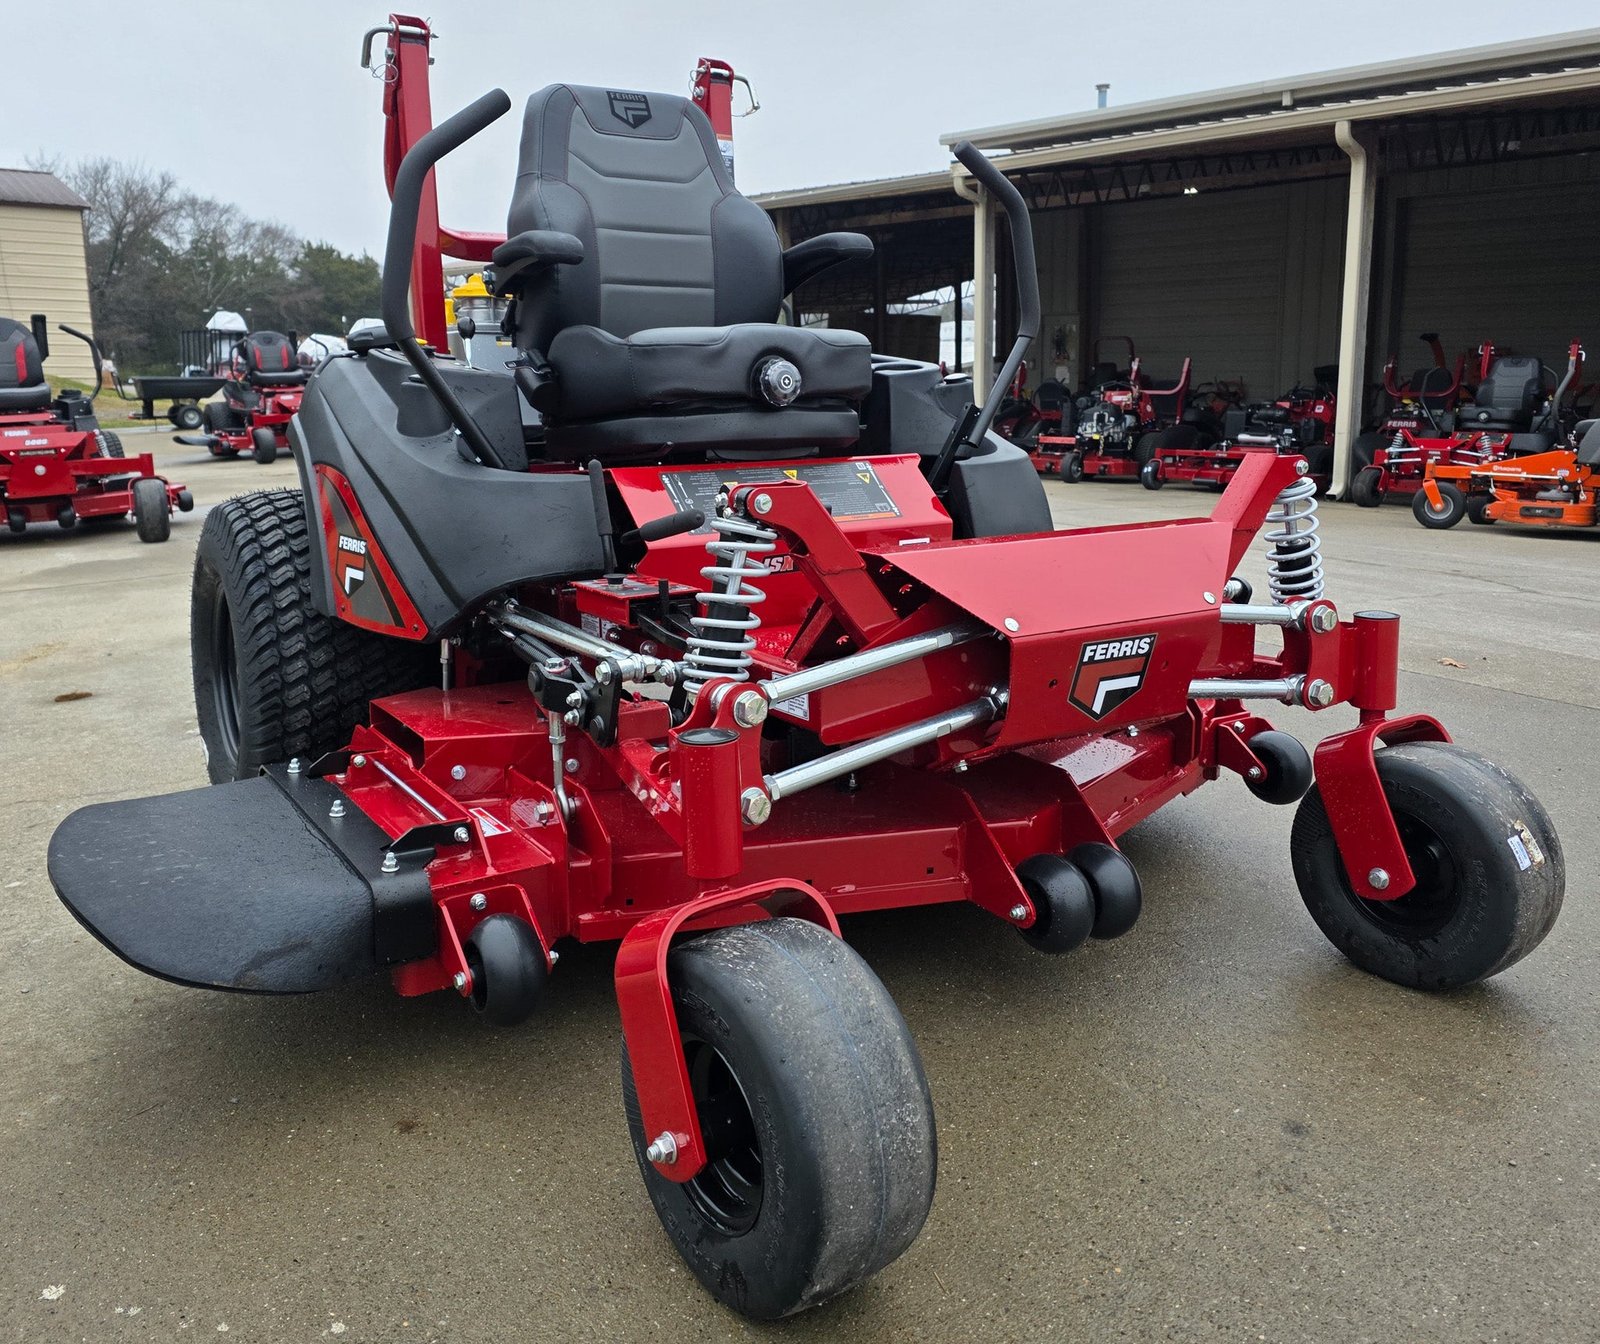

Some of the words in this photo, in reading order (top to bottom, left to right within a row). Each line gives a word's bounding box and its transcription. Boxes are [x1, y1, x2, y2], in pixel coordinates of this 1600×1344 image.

[610, 92, 646, 102] FERRIS
[339, 535, 366, 554] FERRIS
[1083, 637, 1151, 663] FERRIS
